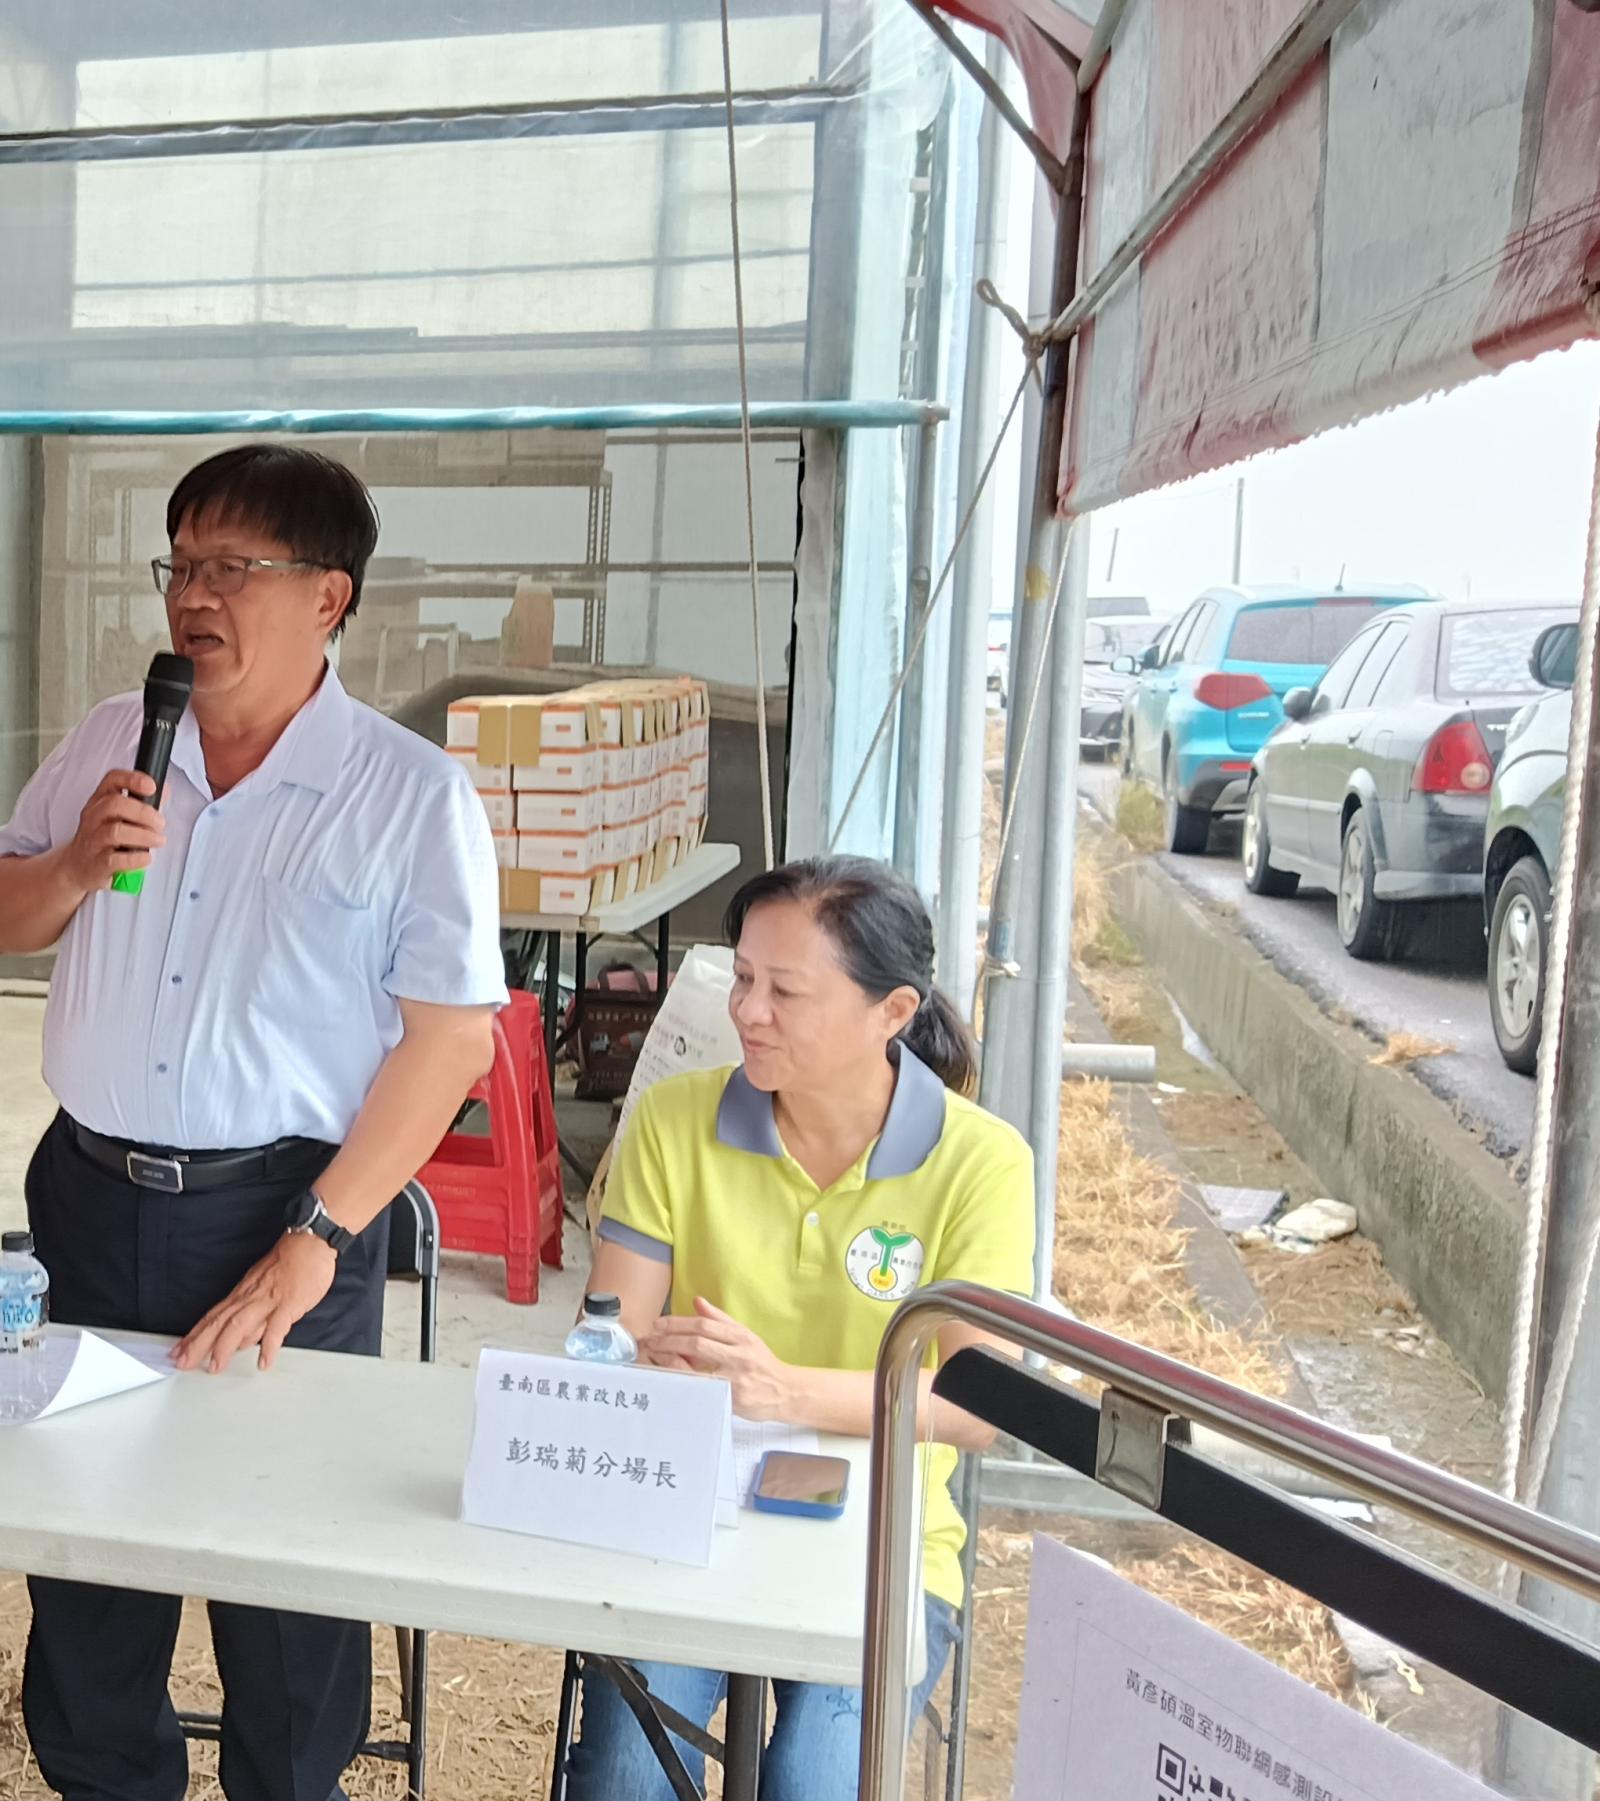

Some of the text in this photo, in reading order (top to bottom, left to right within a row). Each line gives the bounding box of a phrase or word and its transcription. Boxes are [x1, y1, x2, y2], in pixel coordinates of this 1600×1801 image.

[498, 1372, 650, 1412] 臺南區農業改良場
[505, 1436, 678, 1489] 彭瑞菊分場長
